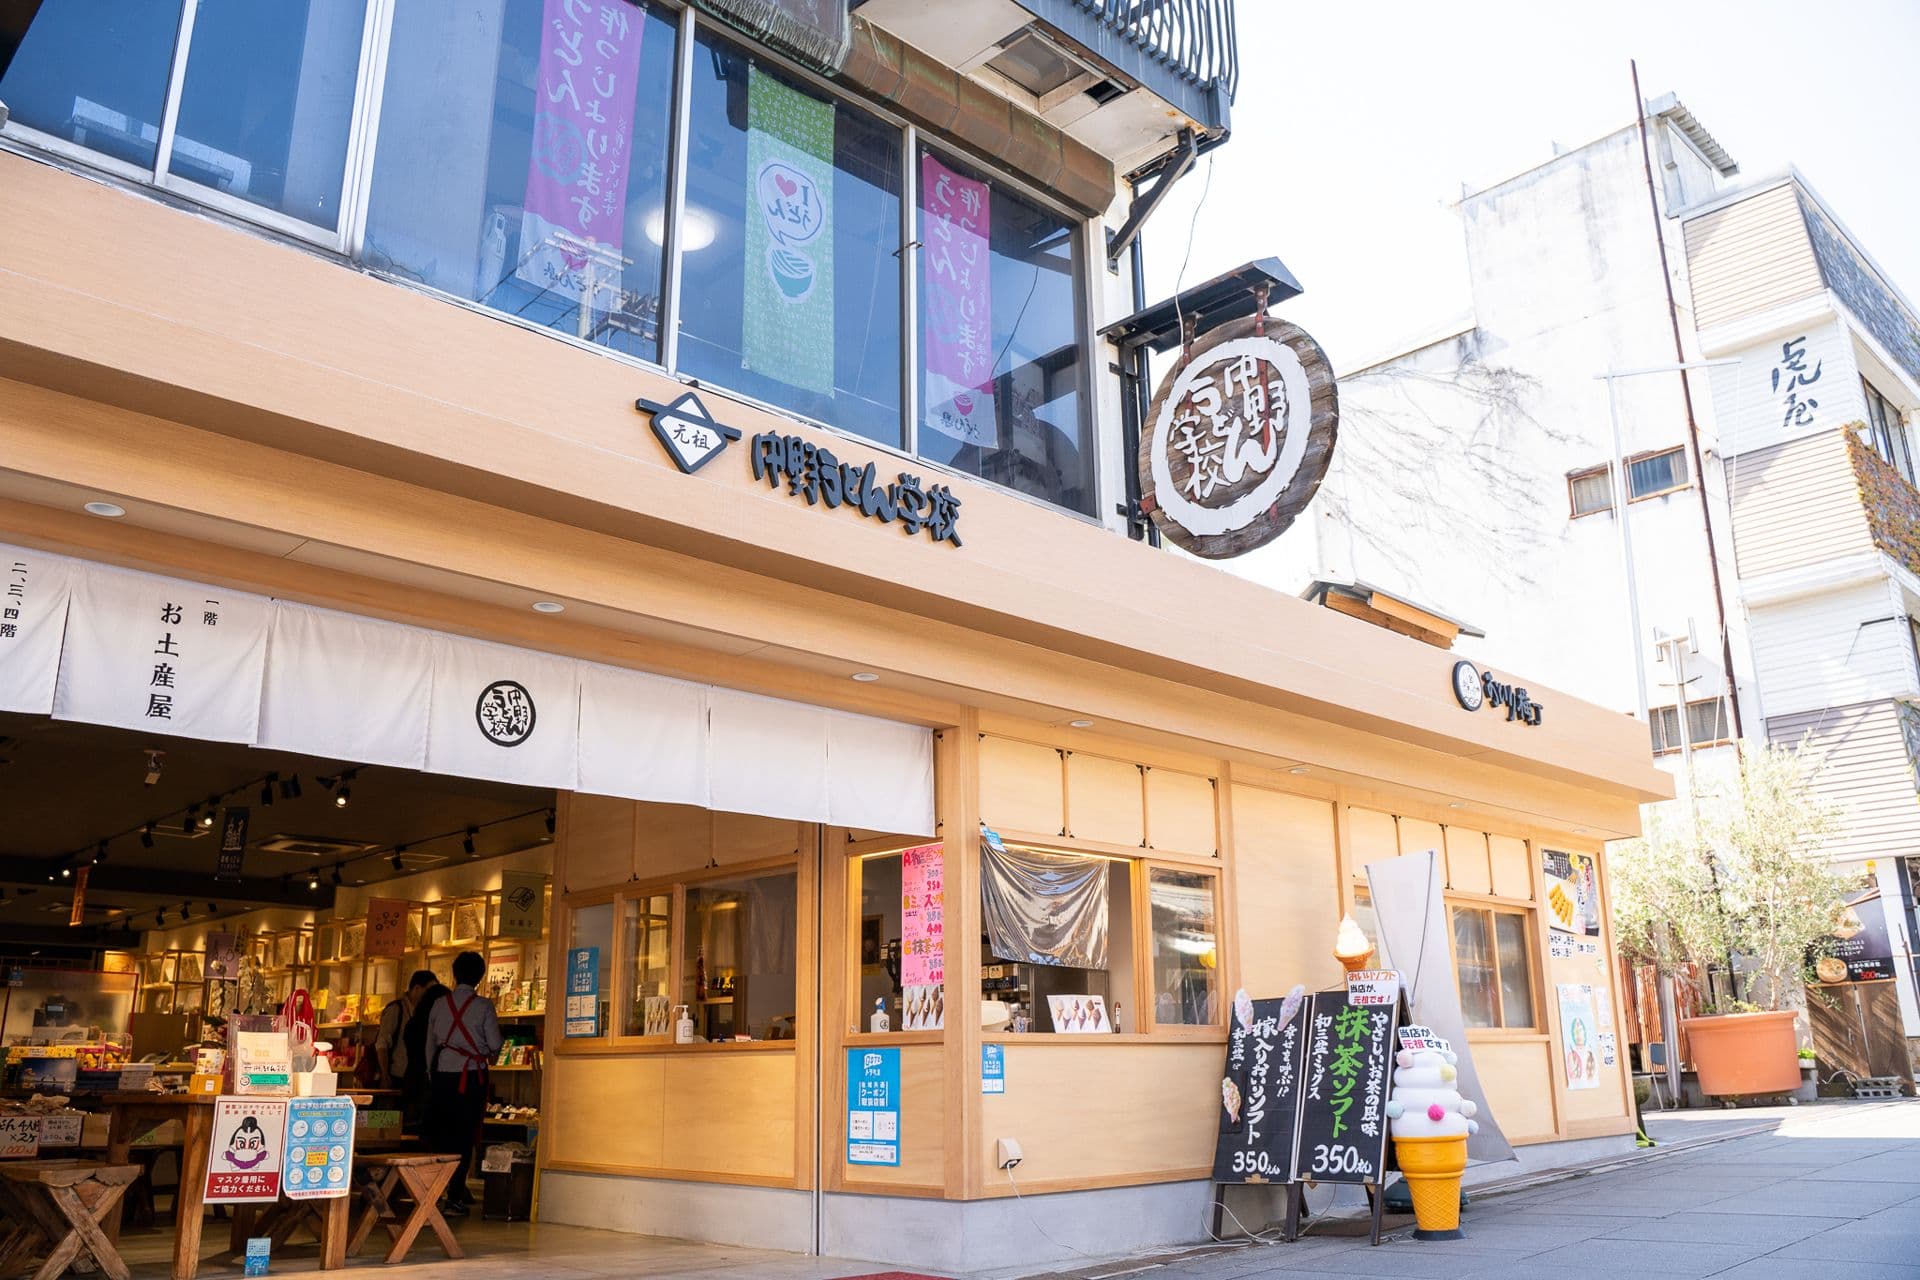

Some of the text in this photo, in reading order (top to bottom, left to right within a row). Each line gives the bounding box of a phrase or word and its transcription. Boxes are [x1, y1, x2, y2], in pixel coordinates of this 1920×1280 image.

[672, 424, 711, 451] 元祖
[751, 430, 963, 547] 中野うどん学校
[203, 599, 220, 626] 一階
[145, 602, 183, 720] お土産屋
[1348, 972, 1396, 981] おいりソフト
[1350, 984, 1377, 993] 当店が、
[1247, 1016, 1278, 1145] 嫁入りおいりソフト
[1308, 1013, 1332, 1100] 和三盆ミックス
[1329, 1006, 1371, 1139] 抹茶ソフト
[1360, 1011, 1389, 1137] やさしいお茶の風味
[861, 1089, 885, 1097] クーポン
[213, 1185, 273, 1193] ご協力ください。
